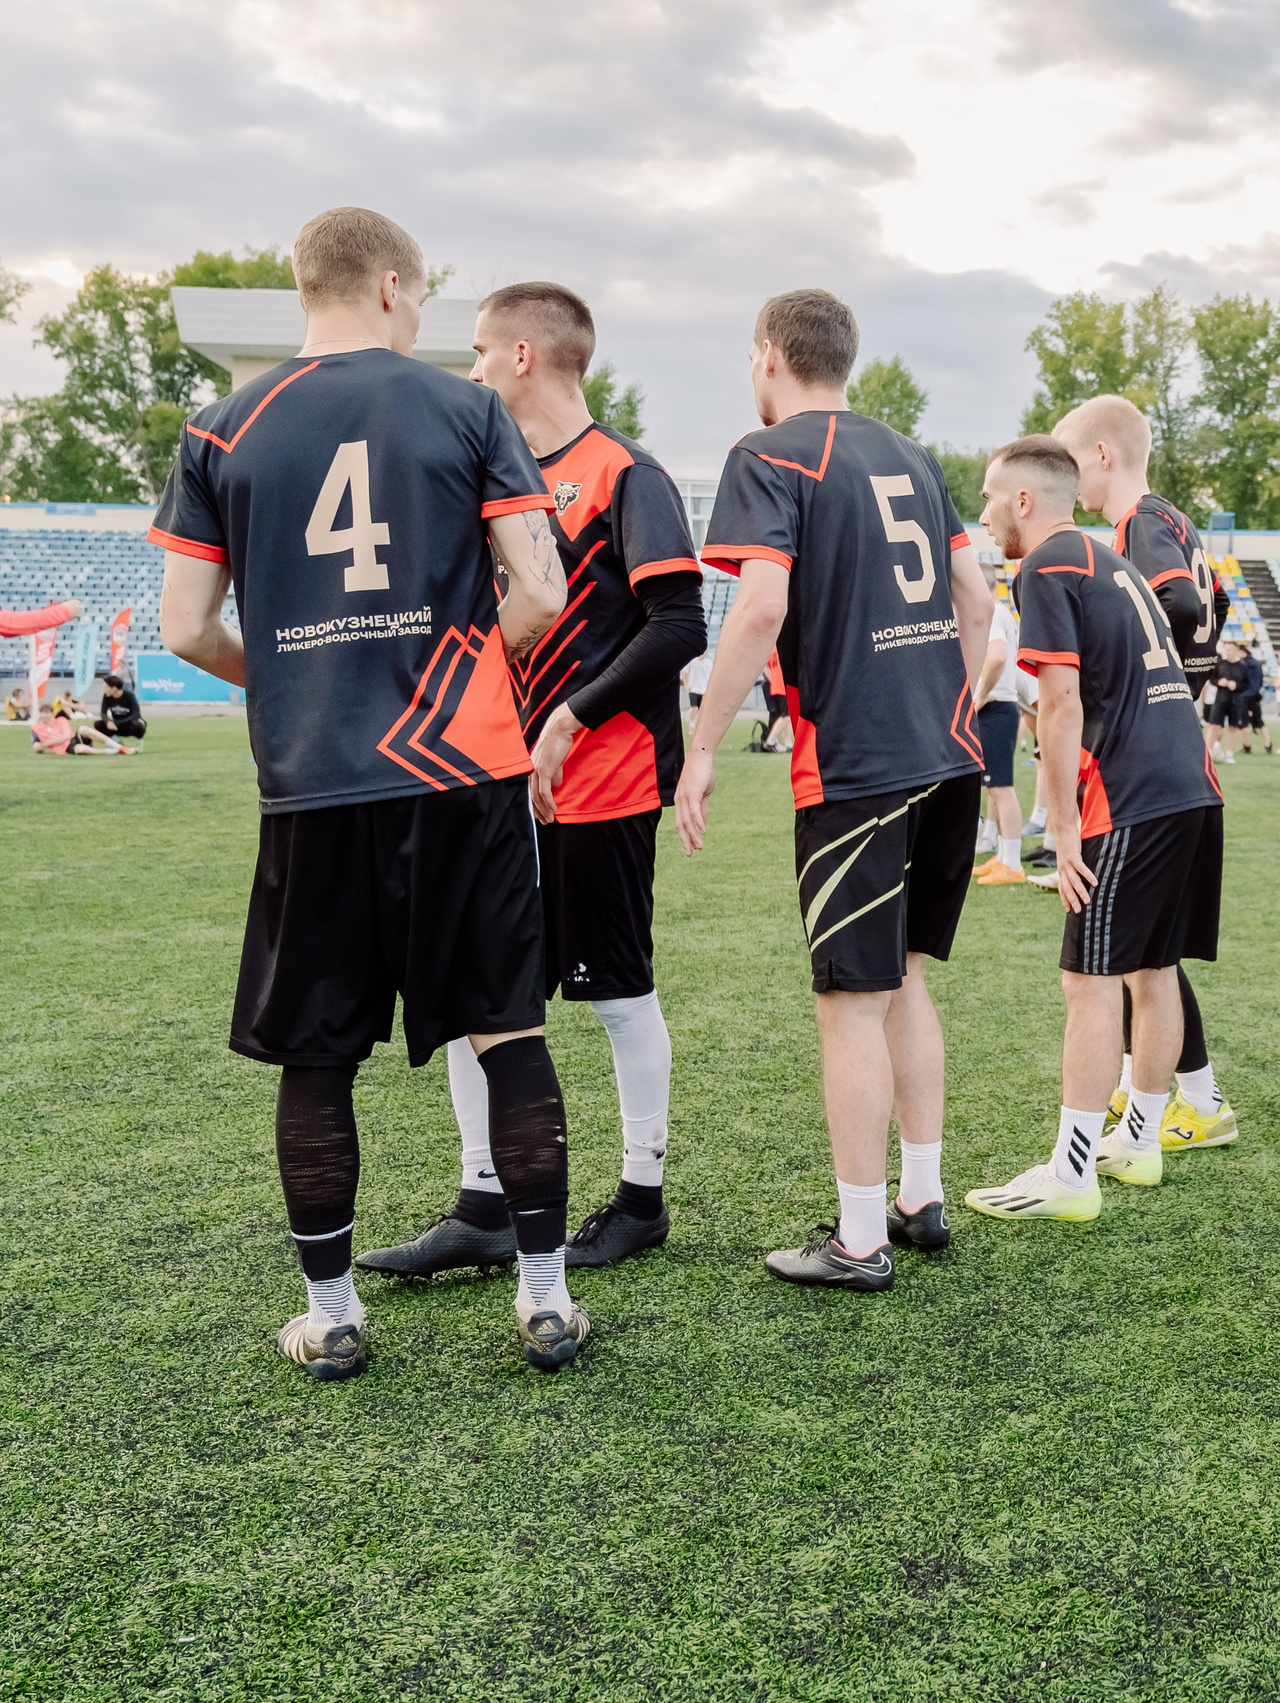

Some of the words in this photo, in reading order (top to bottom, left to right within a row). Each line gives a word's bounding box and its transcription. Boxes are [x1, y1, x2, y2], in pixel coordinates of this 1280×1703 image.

[305, 440, 390, 592] 4
[869, 474, 936, 604] 5
[276, 606, 432, 641] НОВОКУЗНЕЦКИЙ
[277, 626, 396, 653] ЛИКЕРО-ВОДОЧНЫЙ
[398, 625, 432, 636] ЗАВОД
